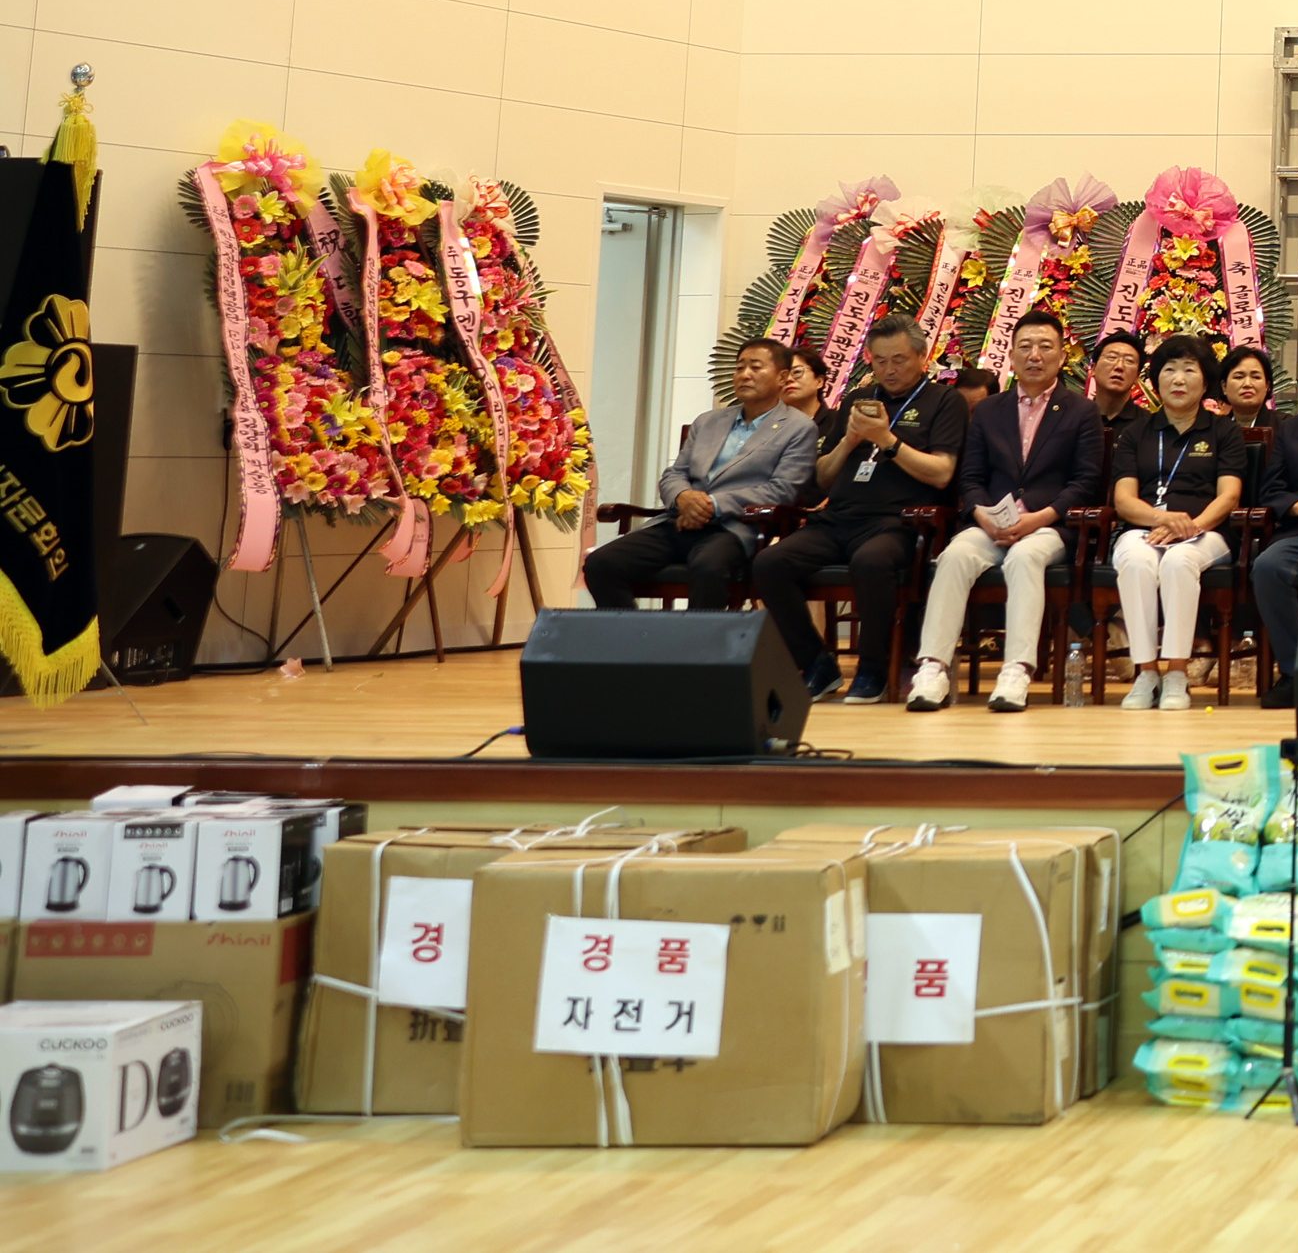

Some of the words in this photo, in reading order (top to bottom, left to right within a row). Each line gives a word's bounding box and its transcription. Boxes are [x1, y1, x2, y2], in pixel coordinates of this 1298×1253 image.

[1227, 261, 1251, 277] 축
[1230, 284, 1256, 330] 글로벌
[410, 923, 444, 965] 경
[913, 959, 949, 998] 품
[159, 1013, 195, 1032] CUCKOO
[38, 1038, 109, 1052] CUCKOO
